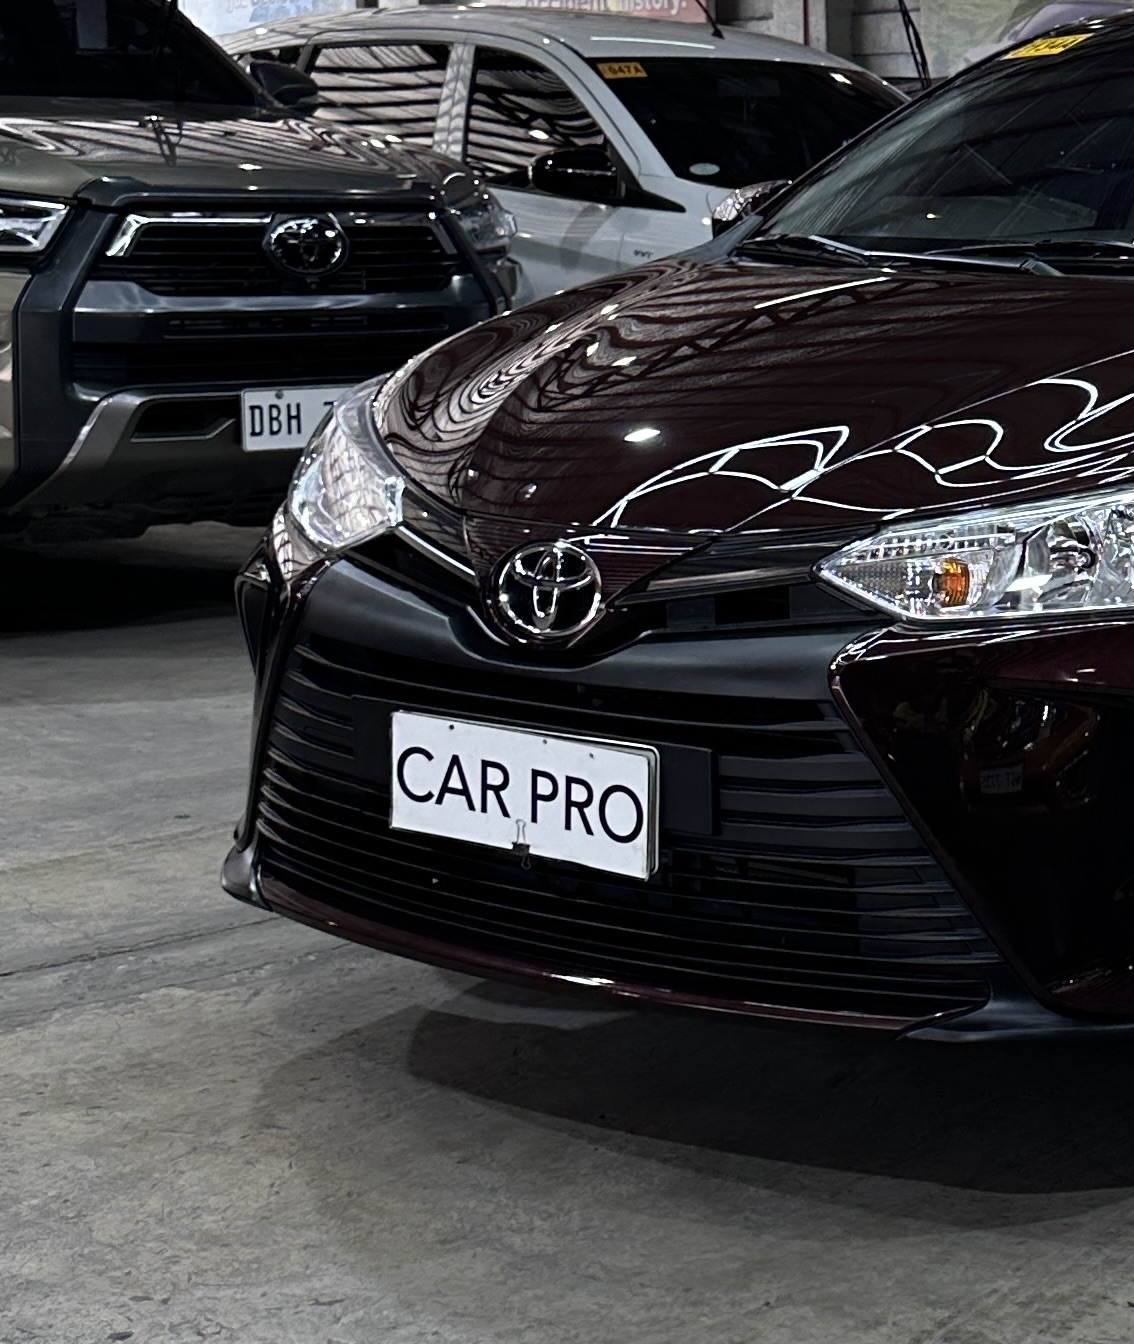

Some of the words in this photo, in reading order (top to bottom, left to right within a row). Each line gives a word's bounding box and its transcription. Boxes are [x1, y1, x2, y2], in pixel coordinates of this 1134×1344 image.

[249, 402, 302, 437] DBH
[396, 746, 511, 818] CAR
[530, 768, 644, 843] PRO
